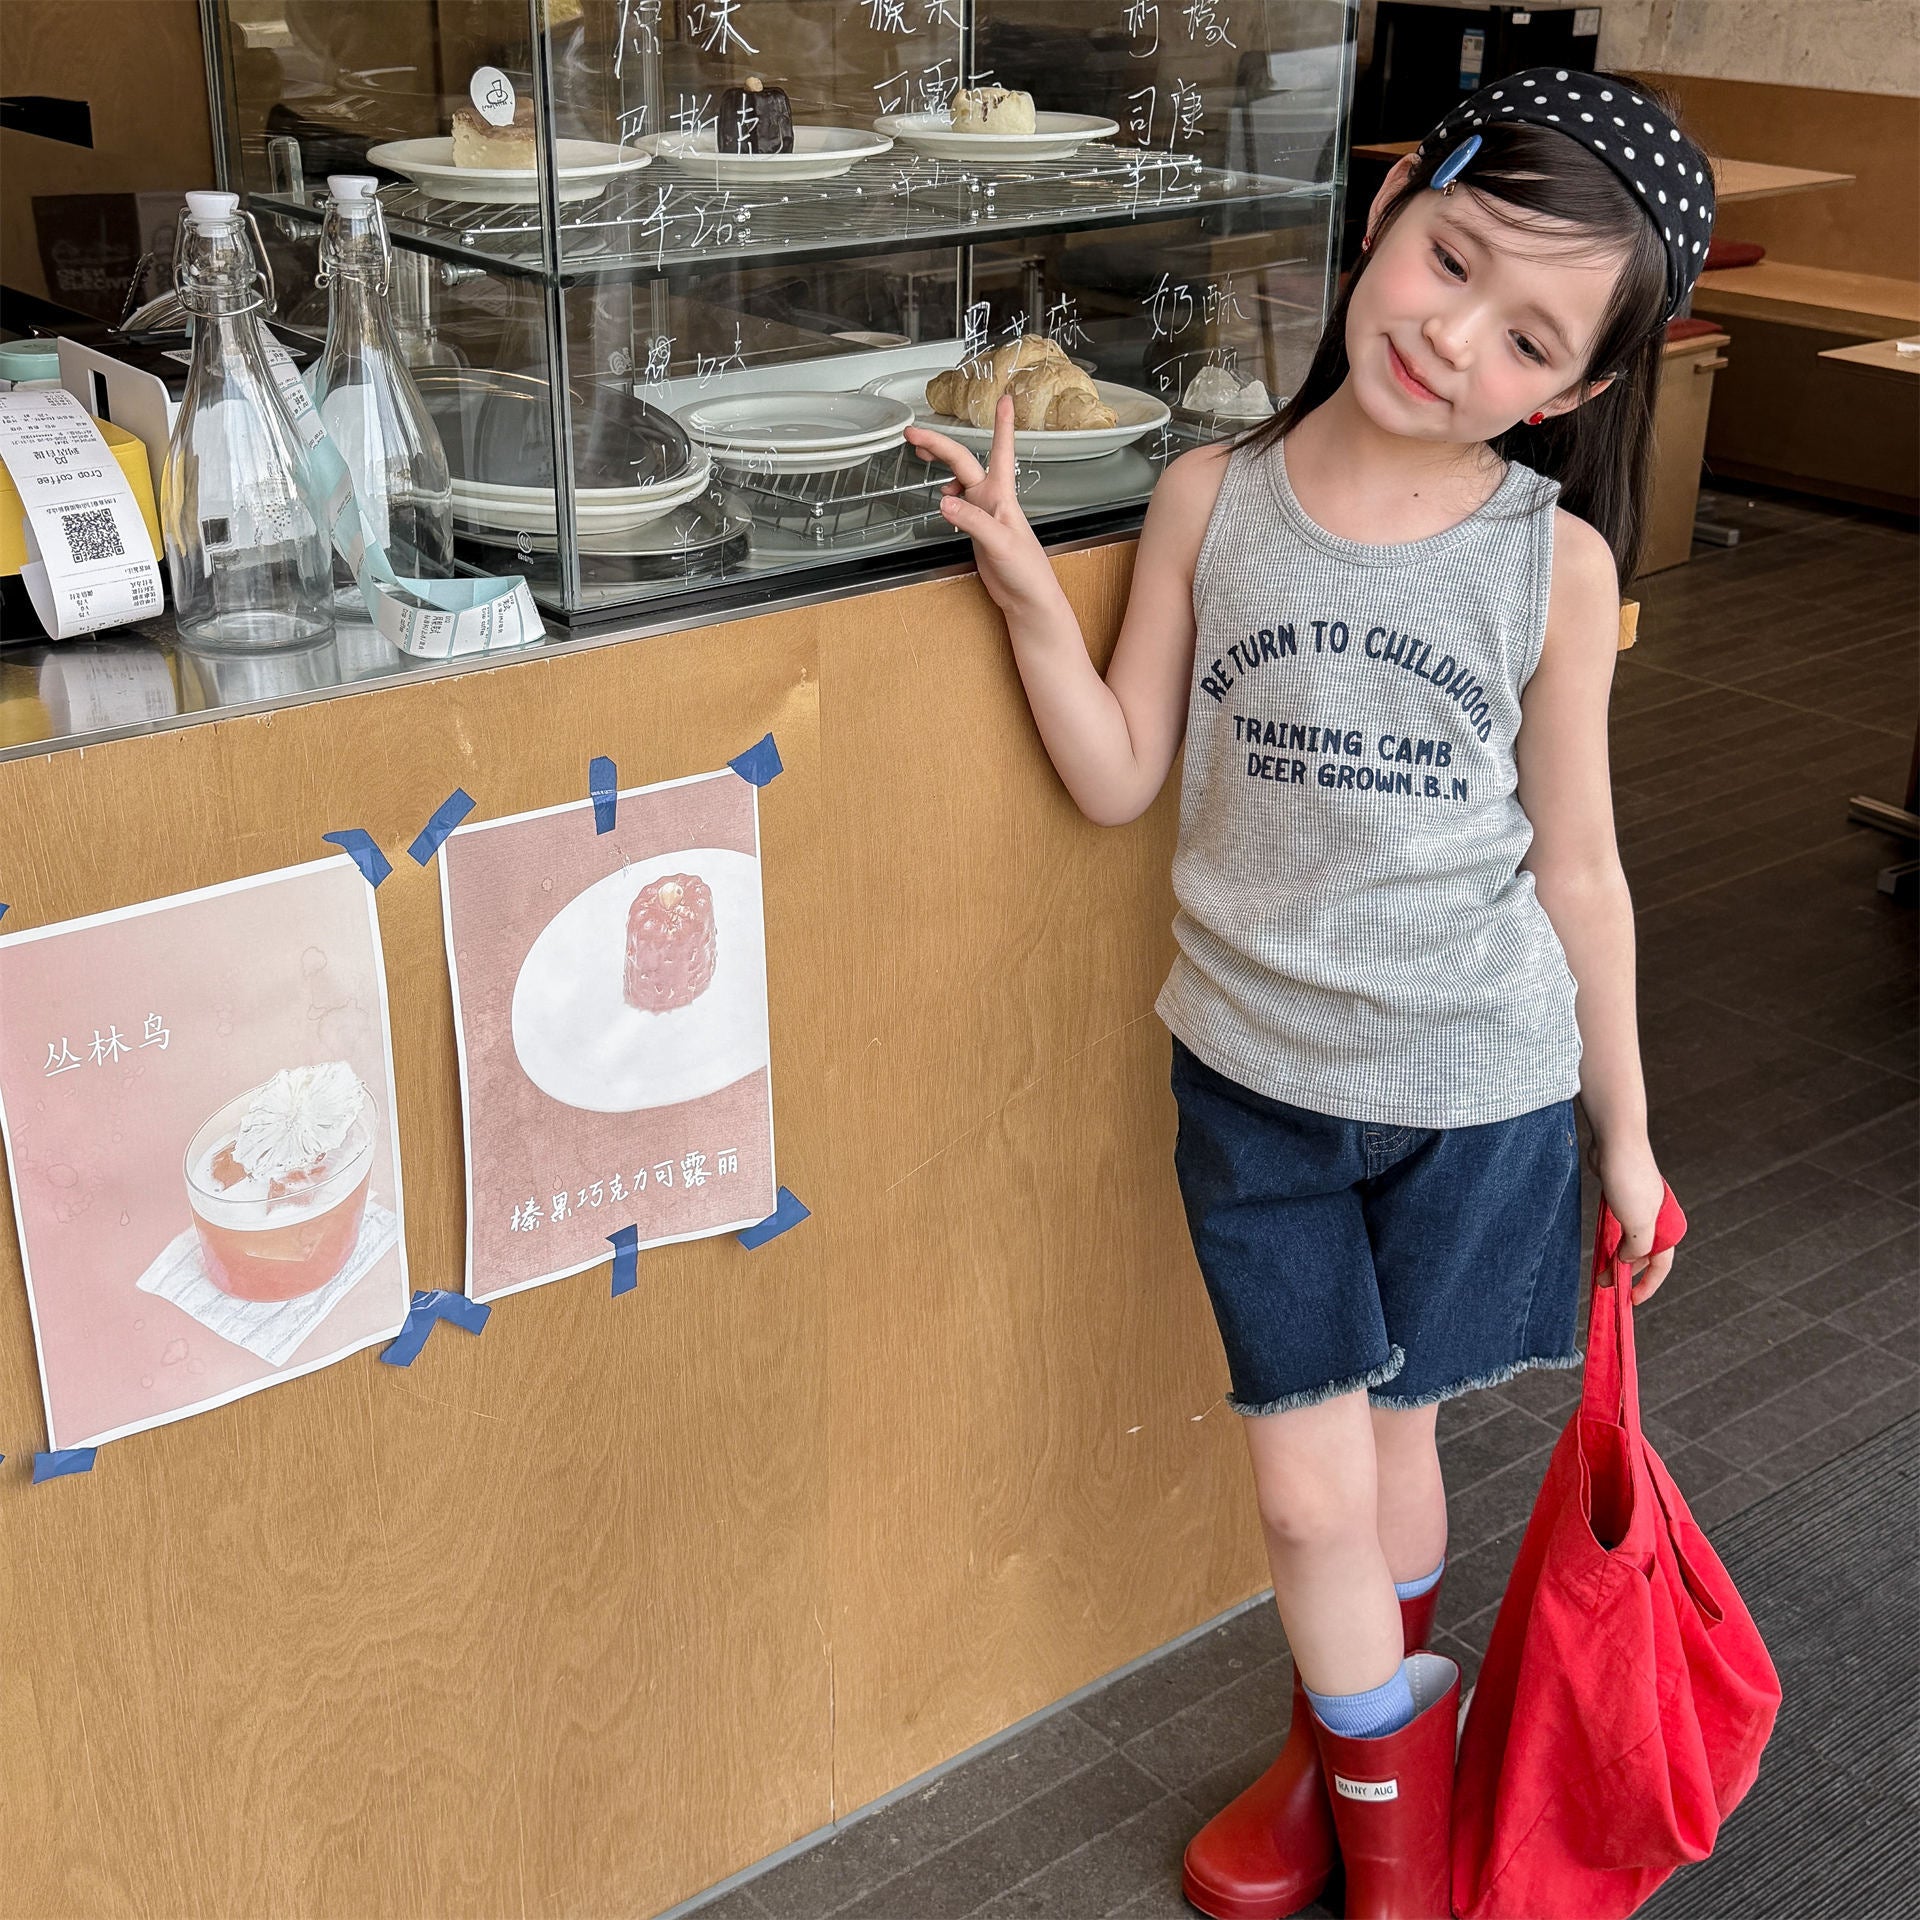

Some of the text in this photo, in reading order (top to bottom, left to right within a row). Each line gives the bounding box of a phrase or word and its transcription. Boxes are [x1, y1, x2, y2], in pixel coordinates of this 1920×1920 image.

[614, 0, 760, 79] 原味
[616, 93, 784, 192] 巴斯克
[1127, 78, 1204, 162] 司康
[955, 292, 1094, 383] 黑芝麻
[37, 469, 103, 485] Crop coffee
[1200, 620, 1492, 744] RETURN TO CHILDHOOD
[1233, 715, 1453, 768] TRAINING CAMB
[1248, 753, 1468, 802] DEER GROWN.B.N
[43, 1012, 171, 1077] 丛林鸟
[510, 1147, 738, 1232] 榛果巧克力可露丽
[1338, 1781, 1394, 1796] RAINY AUG
